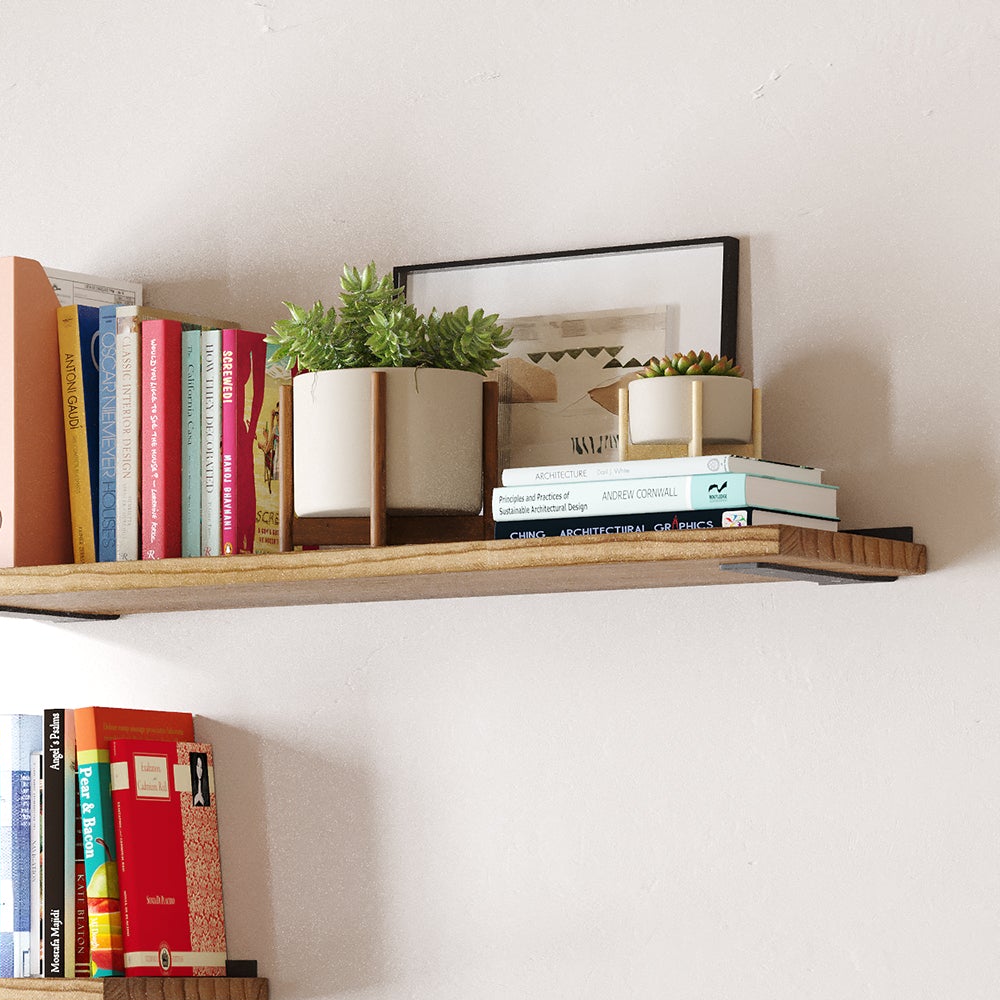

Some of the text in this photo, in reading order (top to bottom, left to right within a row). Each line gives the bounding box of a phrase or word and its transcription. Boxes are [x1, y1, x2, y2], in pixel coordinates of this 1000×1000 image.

[64, 353, 77, 393] ANTONI
[121, 336, 132, 381] CLASSIC
[205, 344, 215, 373] HOW
[187, 364, 195, 417] California
[205, 377, 215, 410] THEY
[67, 395, 83, 430] GAUDÍ
[121, 384, 132, 434] INTERIOR
[101, 332, 116, 549] OSCAR NIEMEYER HOUSES
[187, 421, 195, 447] Casa
[121, 438, 132, 479] DESIGN
[205, 416, 215, 494] DECORATED
[535, 468, 588, 481] ARCHITECTURE
[498, 490, 571, 505] Principles and Practices of
[498, 501, 588, 515] Sustainable Architectural Design
[602, 486, 678, 502] ANDREW CORNWALL
[510, 530, 546, 540] CHING
[653, 514, 715, 531] GRAPHICS
[49, 712, 60, 740] Psalms
[79, 766, 97, 860] Pear & Bacon
[50, 909, 63, 938] Majidi
[77, 874, 85, 954] KATE BEATON
